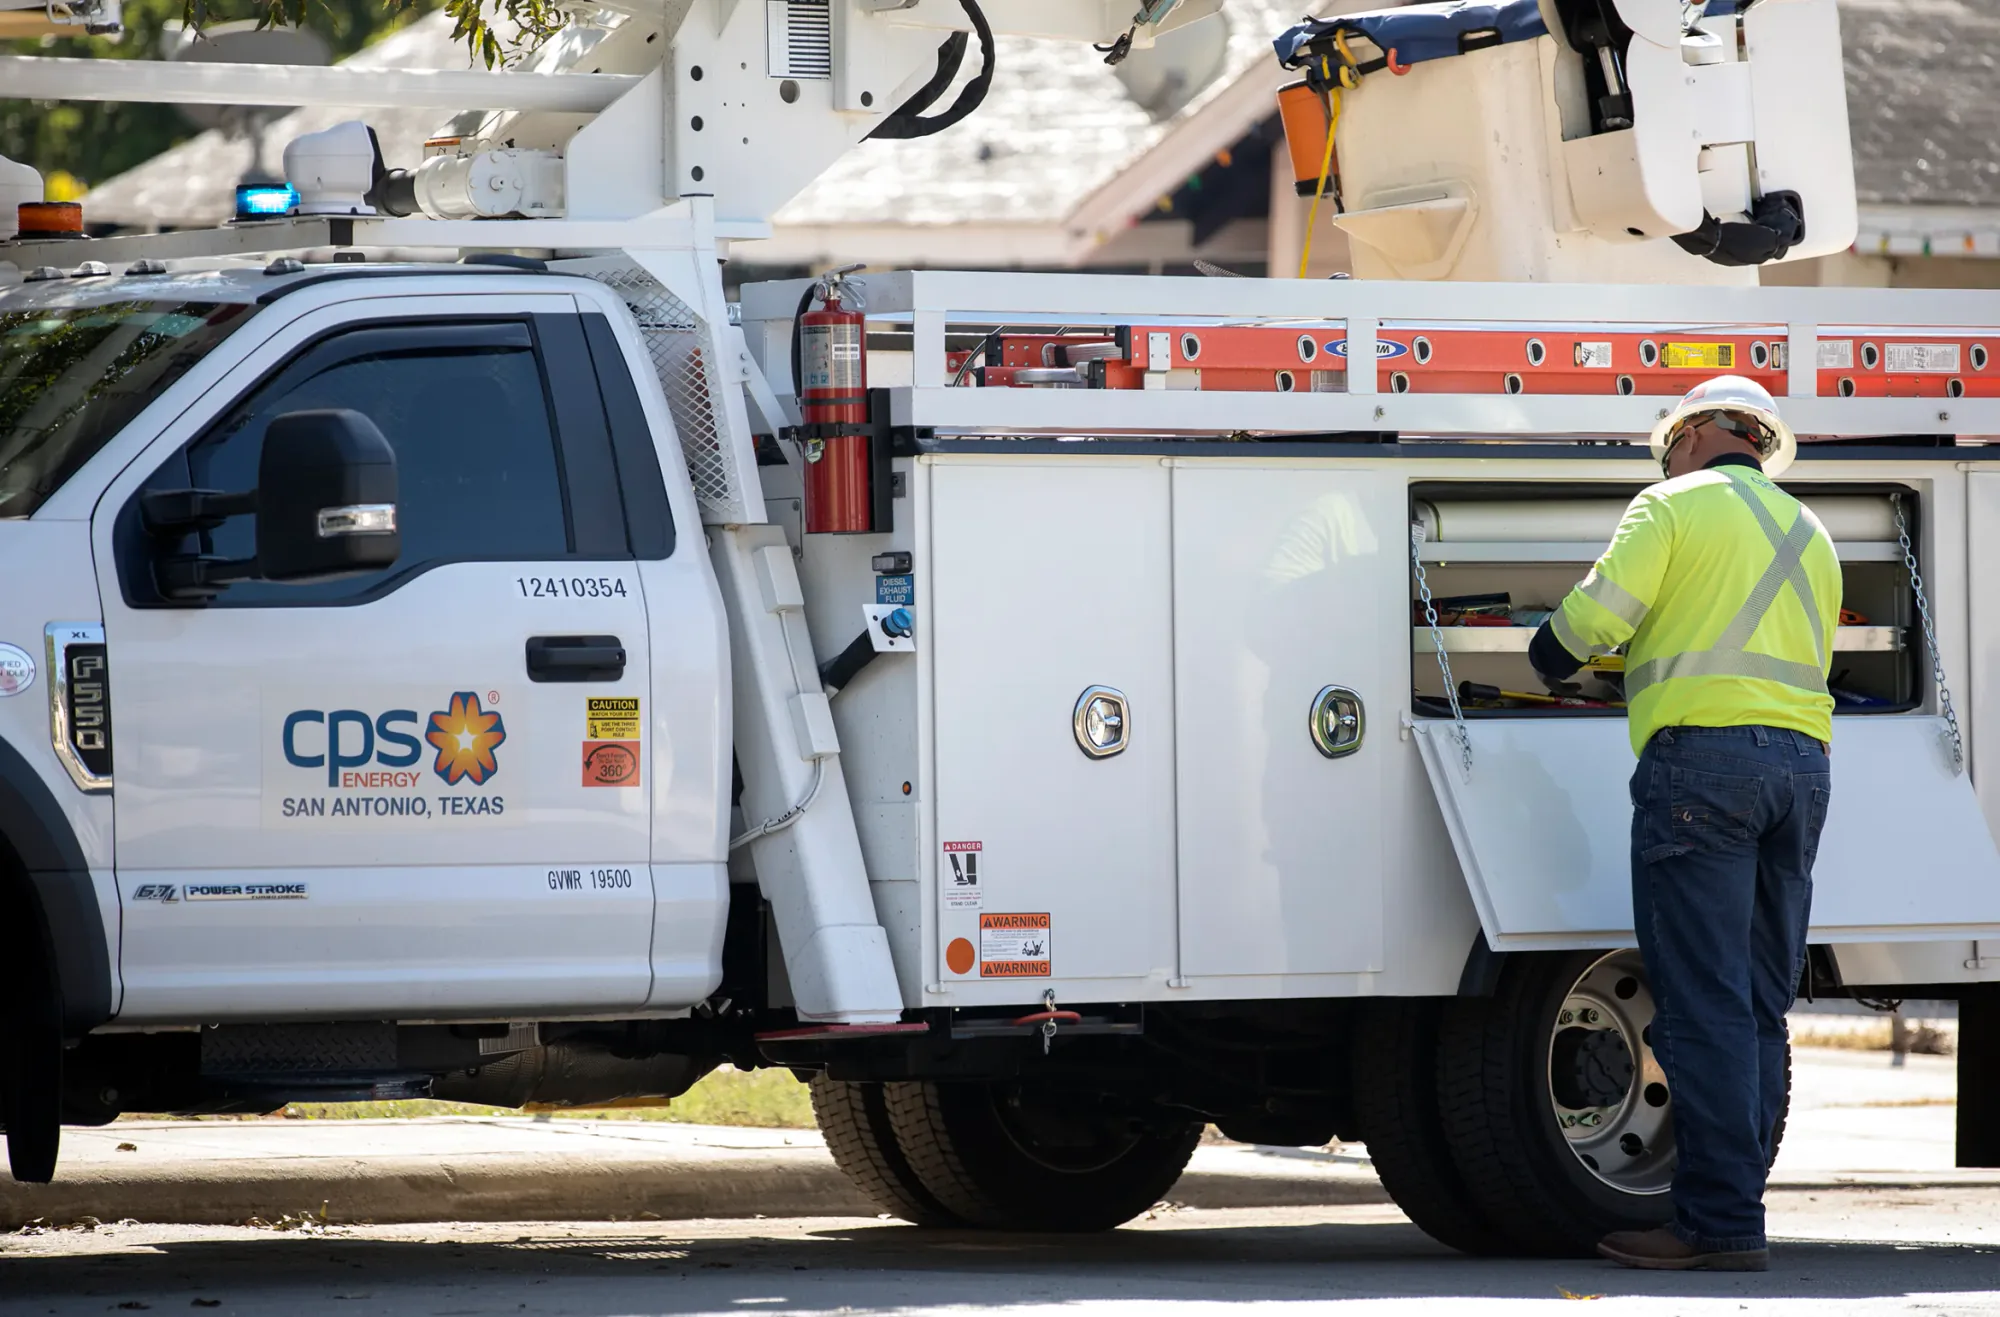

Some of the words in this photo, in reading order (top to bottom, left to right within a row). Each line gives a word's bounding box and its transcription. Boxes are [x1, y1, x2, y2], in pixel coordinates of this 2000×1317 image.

[517, 577, 627, 598] 12410354
[882, 578, 907, 586] DIESEL
[880, 586, 911, 595] EXHAUST
[886, 595, 906, 603] FLUID
[71, 631, 90, 639] XL
[591, 700, 635, 710] CAUTION
[282, 709, 422, 788] cps
[343, 772, 421, 788] ENERGY
[282, 797, 325, 817] SAN
[331, 797, 432, 819] ANTONIO,
[438, 796, 504, 815] TEXAS
[547, 870, 582, 890] GVWR
[590, 869, 632, 889] 19500
[189, 886, 242, 895] POWER
[246, 885, 305, 895] STROKE
[992, 916, 1047, 927] WARNING
[993, 963, 1047, 974] WARNING
